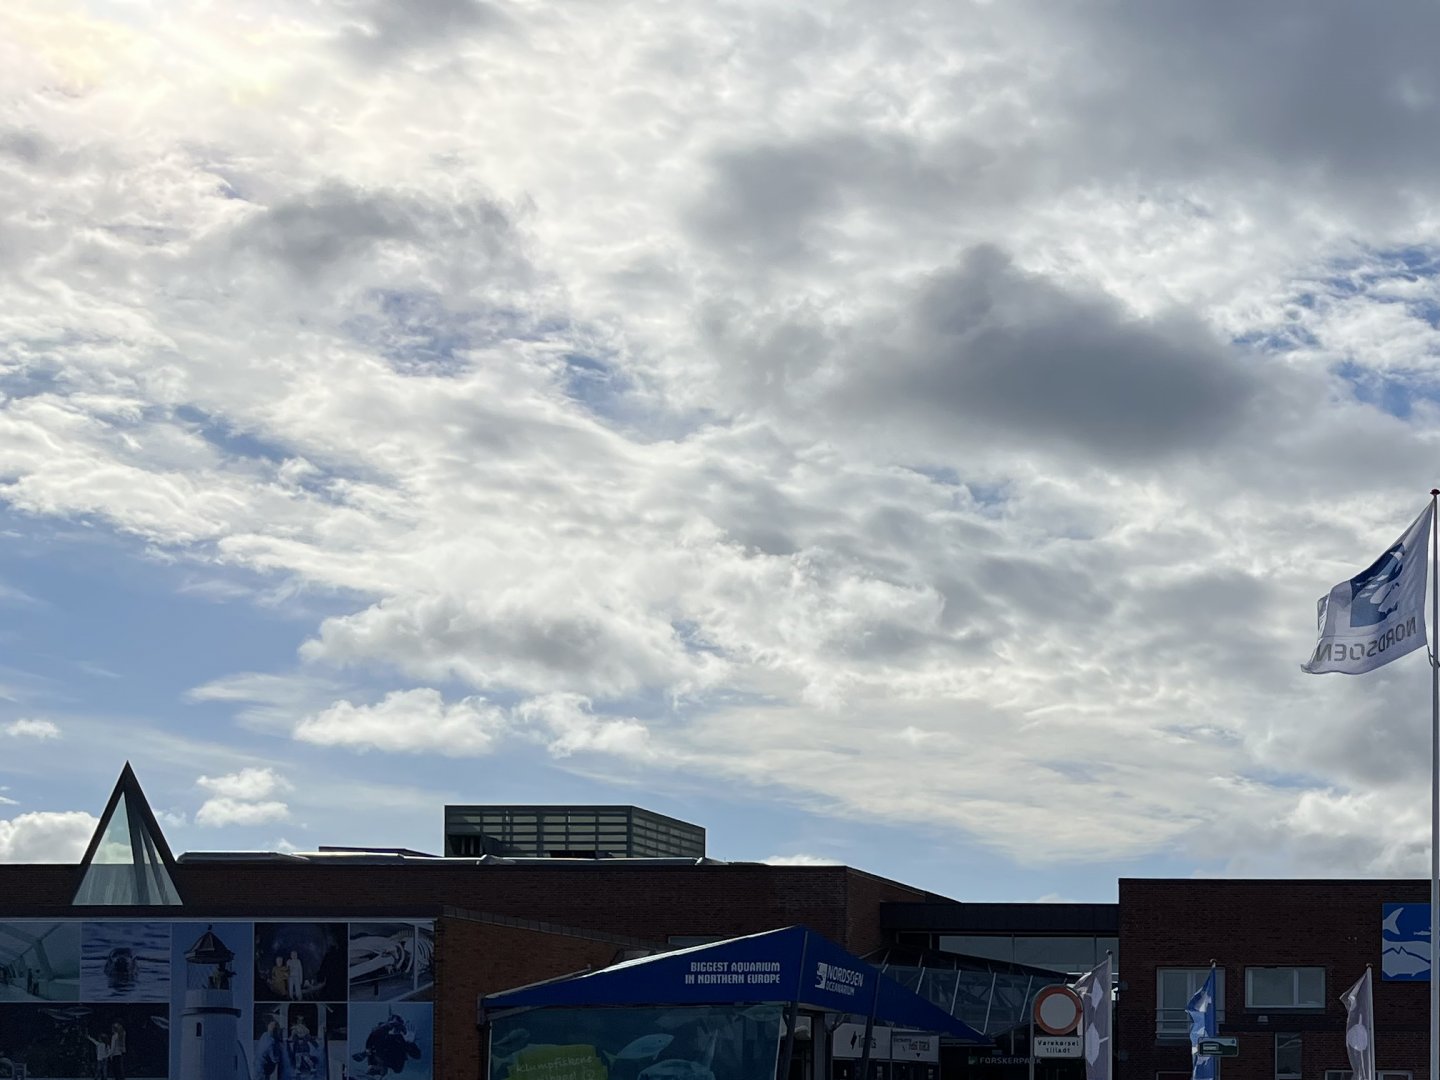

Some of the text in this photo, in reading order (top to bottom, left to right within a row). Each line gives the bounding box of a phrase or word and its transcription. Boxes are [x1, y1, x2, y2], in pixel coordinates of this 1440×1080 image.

[690, 961, 781, 973] BIGGEST AQUARIUM
[685, 974, 781, 985] IN NORTHERN EUROPE
[979, 1056, 1042, 1065] FORSKERPAK
